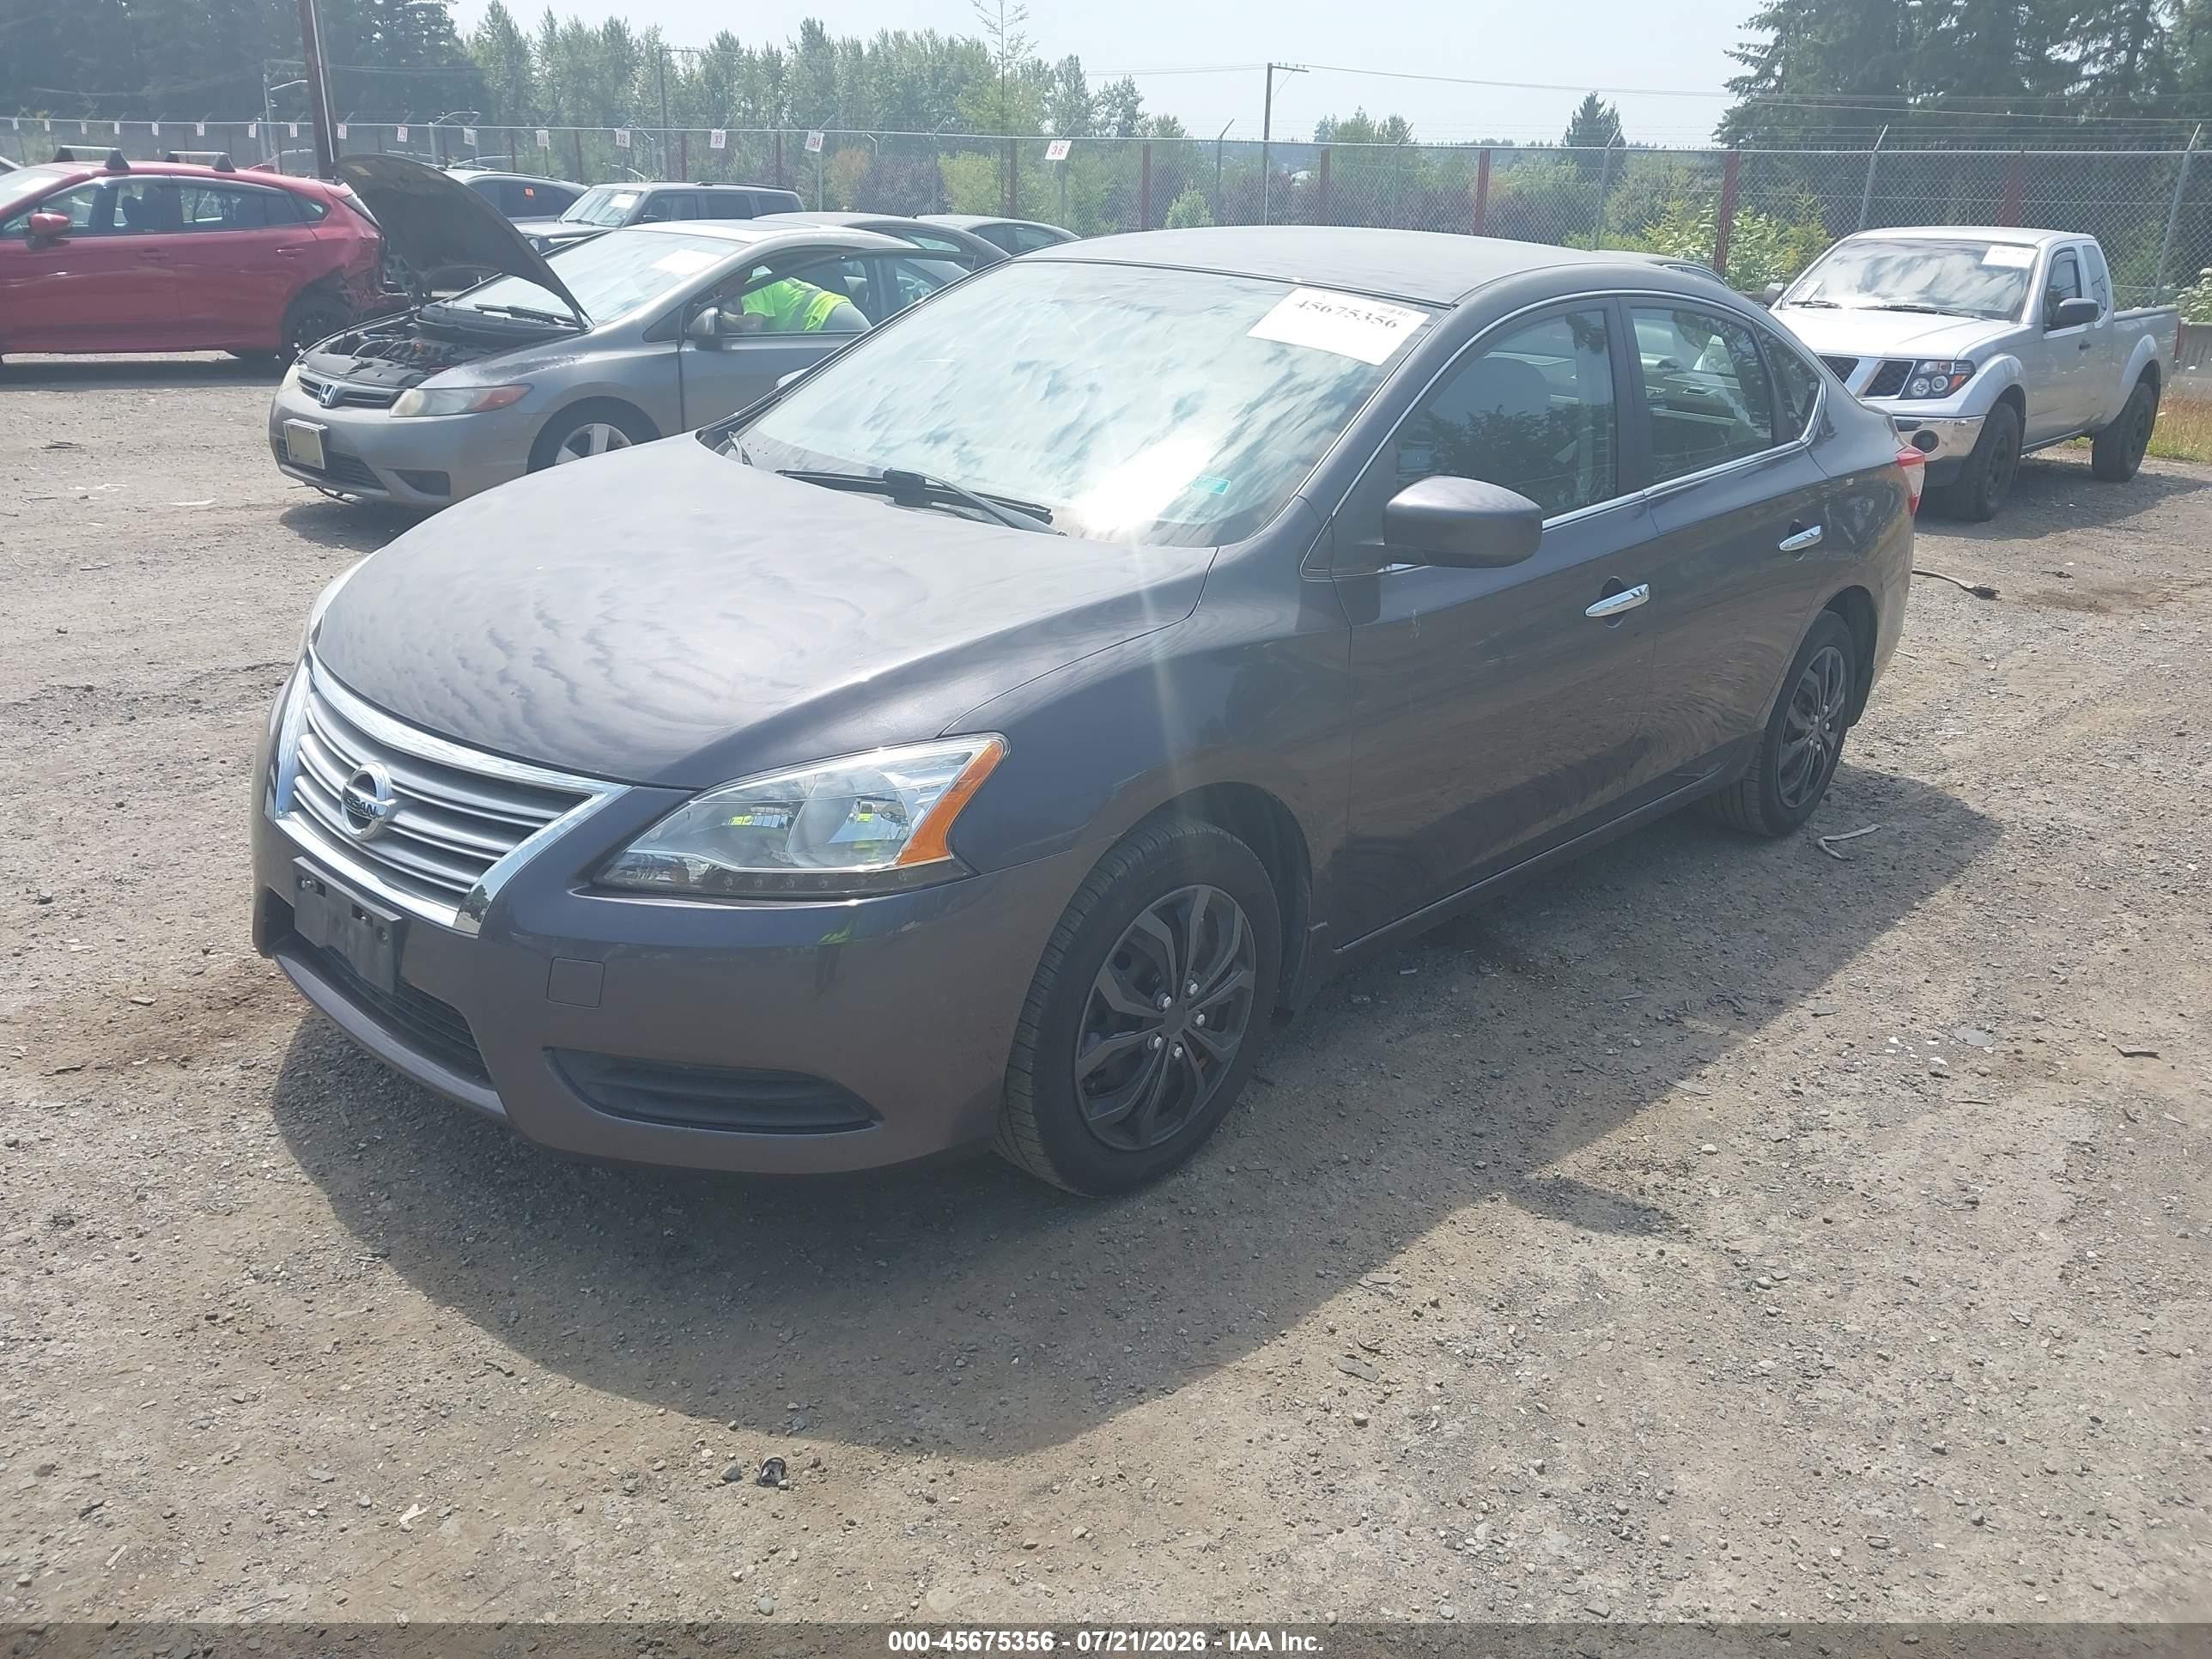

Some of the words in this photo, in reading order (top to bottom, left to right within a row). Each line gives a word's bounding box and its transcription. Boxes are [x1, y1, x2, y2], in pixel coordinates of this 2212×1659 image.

[1051, 145, 1065, 155] 36
[1294, 300, 1399, 329] 45675356
[344, 792, 378, 816] SSAN
